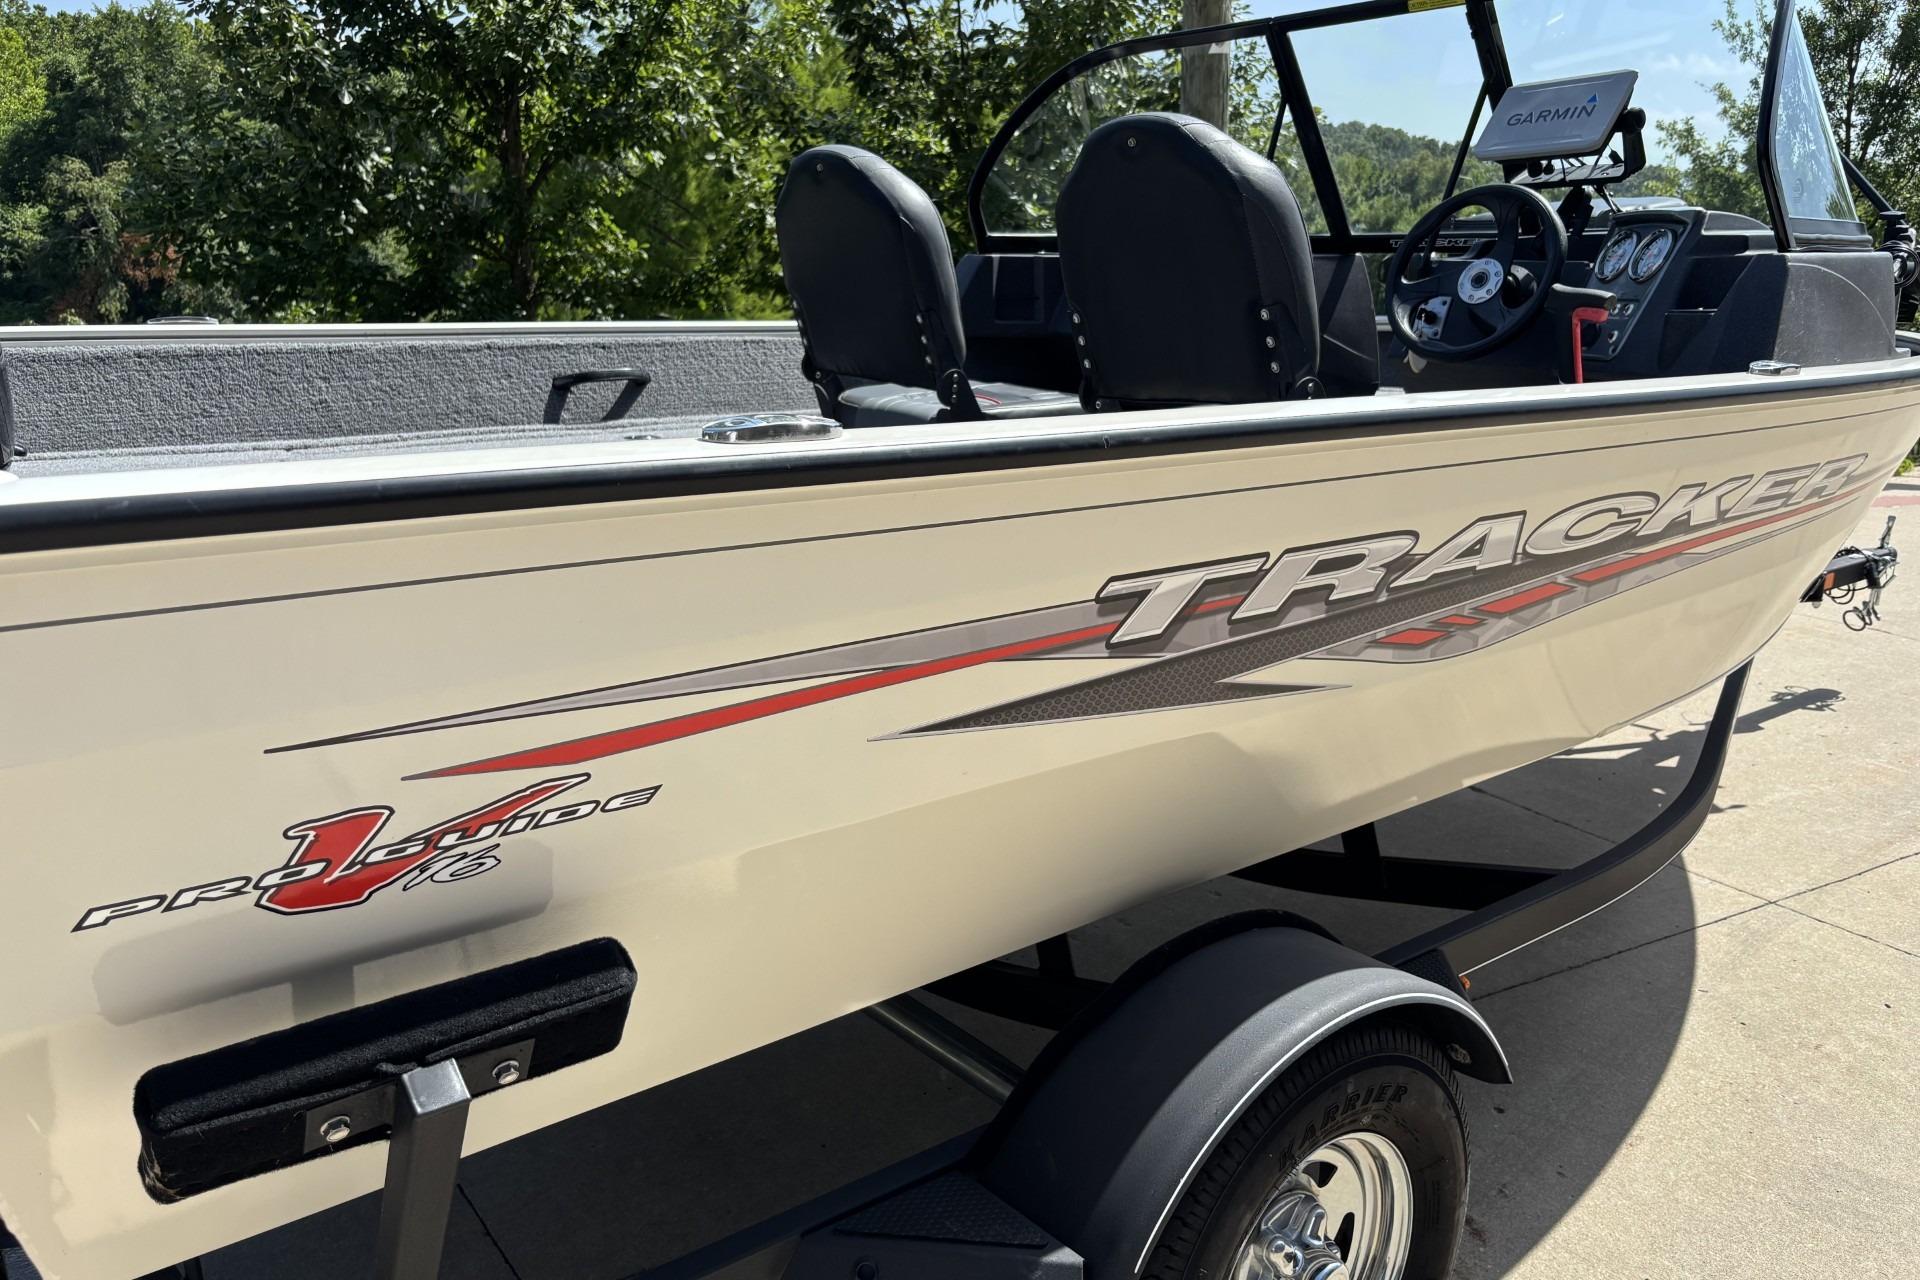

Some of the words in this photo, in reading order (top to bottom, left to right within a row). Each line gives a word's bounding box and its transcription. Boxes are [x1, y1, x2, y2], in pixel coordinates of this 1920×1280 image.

[1507, 104, 1596, 126] GARMIN
[1095, 453, 1867, 647] TRACKER
[402, 842, 501, 893] 16
